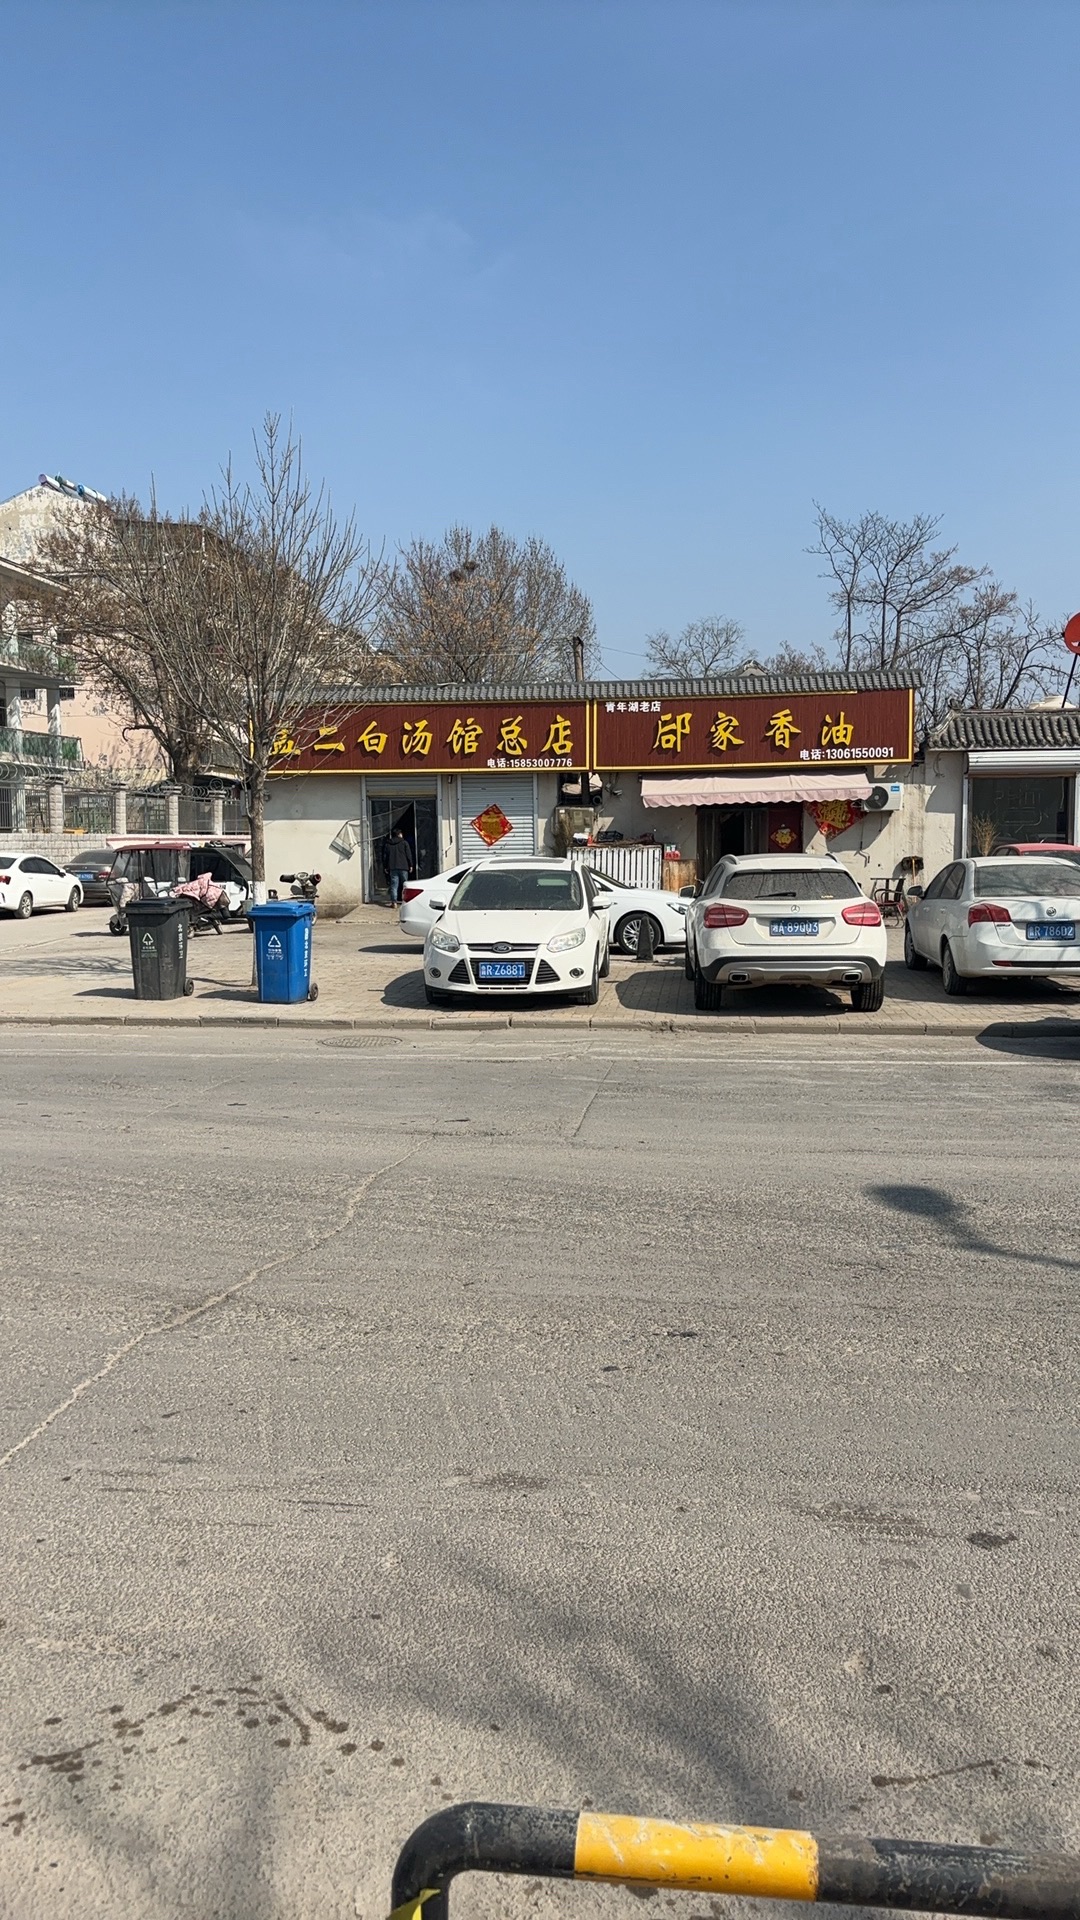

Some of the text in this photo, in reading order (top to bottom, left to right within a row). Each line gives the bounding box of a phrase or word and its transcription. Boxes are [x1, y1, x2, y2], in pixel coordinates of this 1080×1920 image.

[605, 701, 661, 713] 青年湖老店
[800, 747, 894, 760] 电话:13061550091
[487, 758, 573, 768] 电话:15853007776
